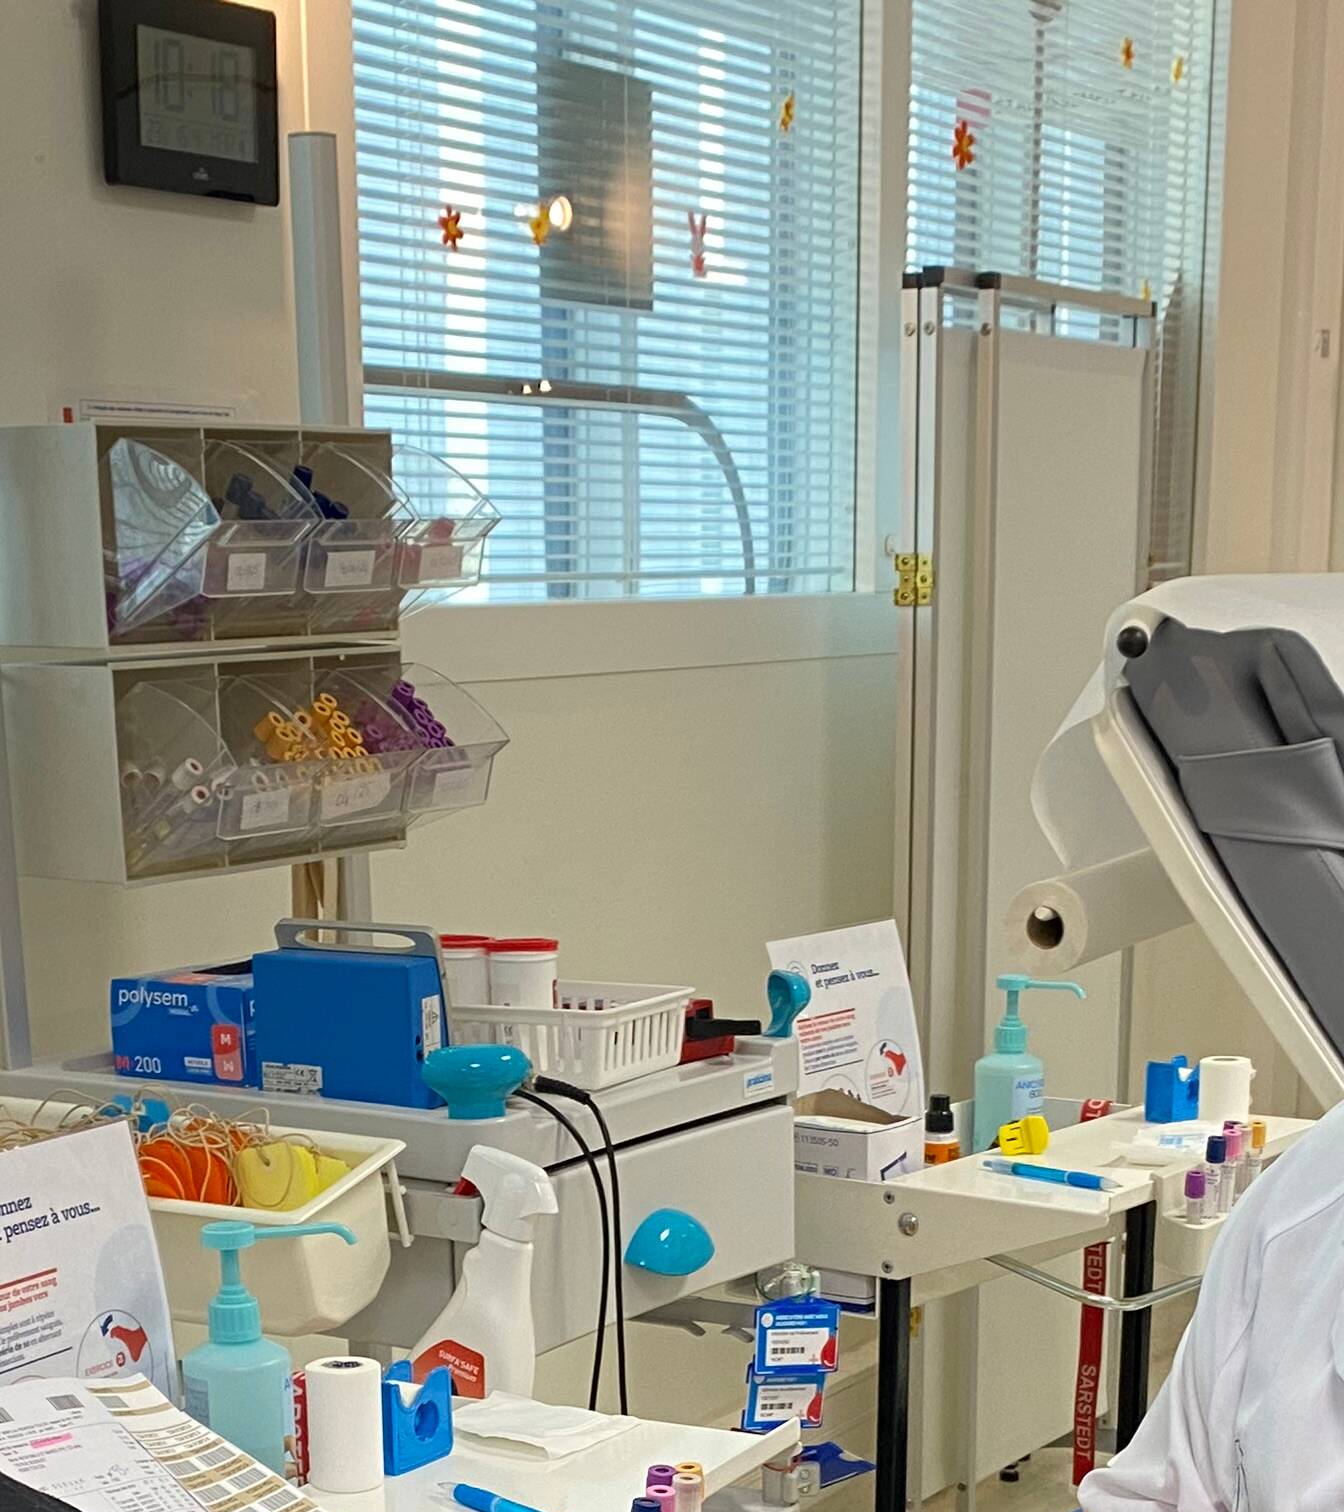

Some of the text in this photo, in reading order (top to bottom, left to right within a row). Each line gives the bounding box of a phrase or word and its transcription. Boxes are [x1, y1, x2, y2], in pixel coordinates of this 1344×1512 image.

[118, 986, 188, 1010] polysem
[220, 1033, 231, 1045] M
[134, 1055, 162, 1074] 200
[5, 1215, 50, 1243] pensez
[50, 1207, 60, 1224] à
[1086, 1244, 1105, 1292] TEDT
[1074, 1364, 1097, 1461] SARSTEDT
